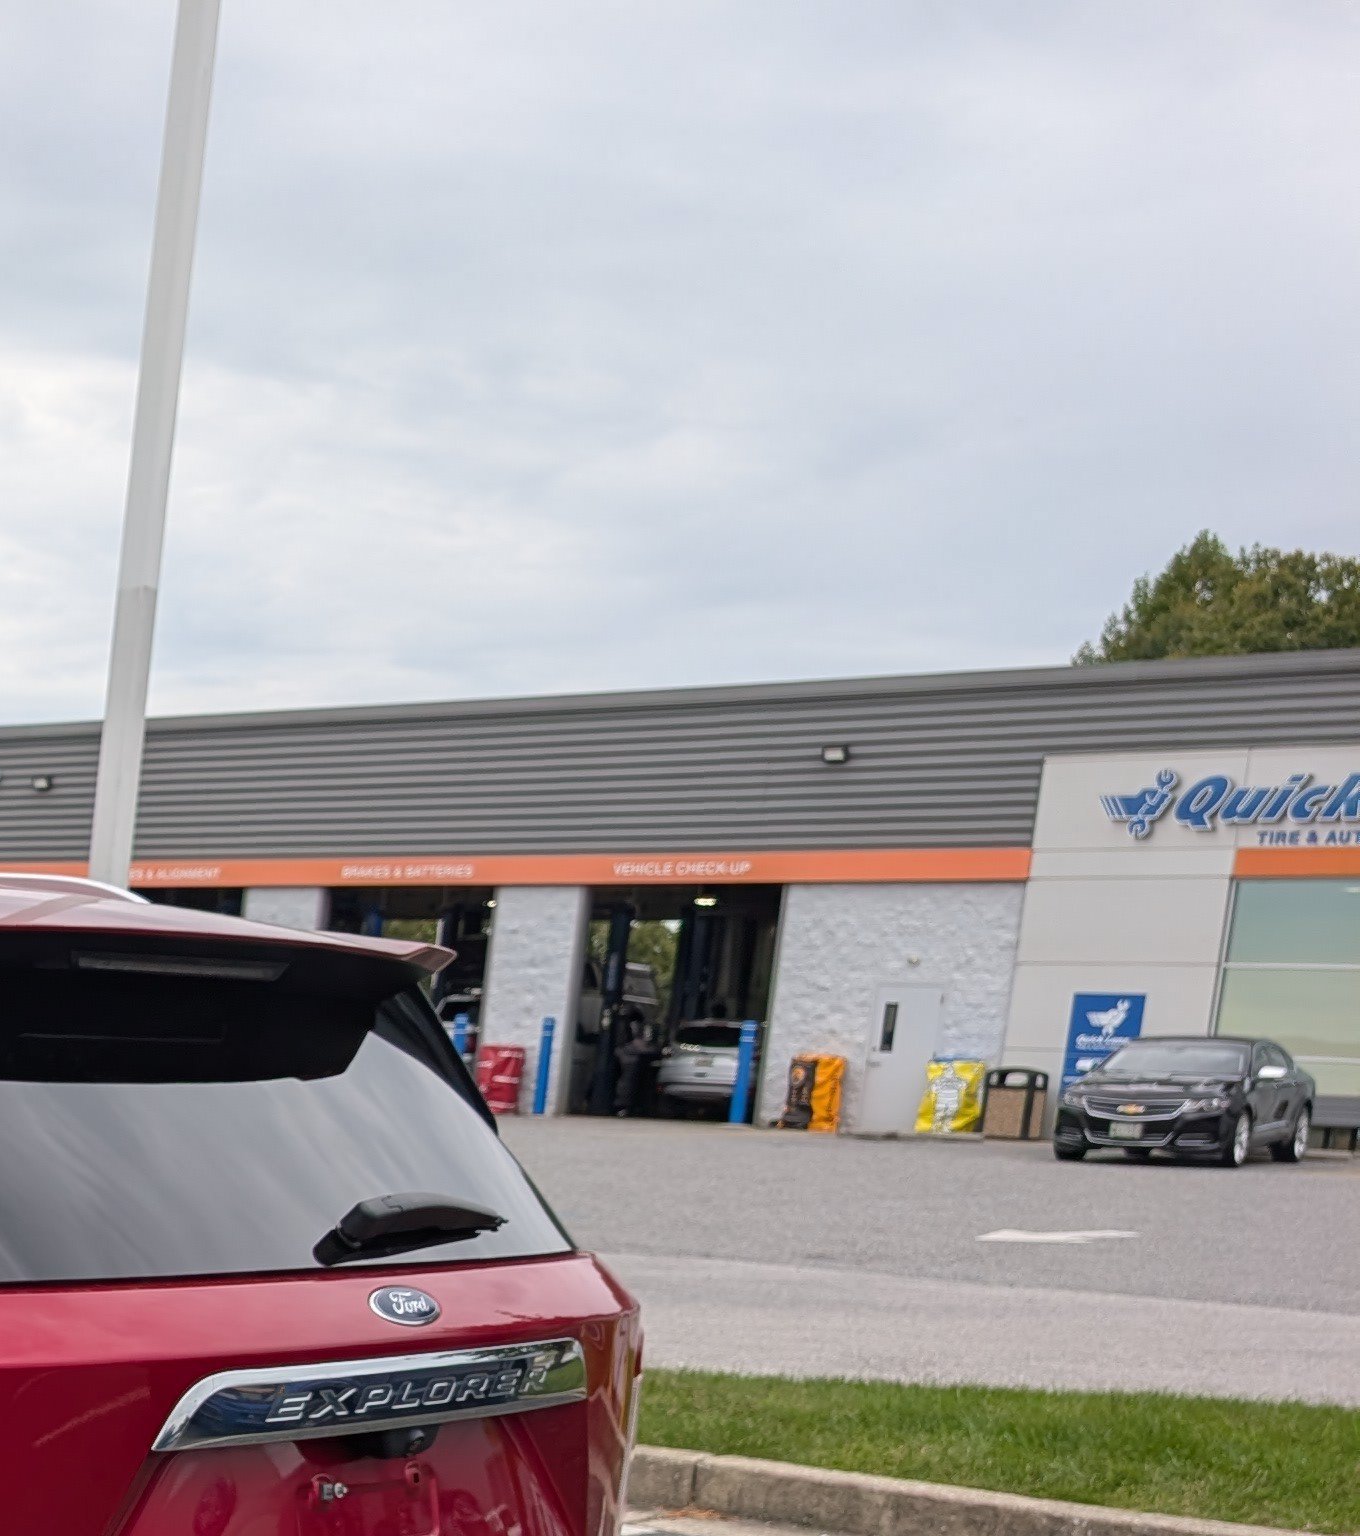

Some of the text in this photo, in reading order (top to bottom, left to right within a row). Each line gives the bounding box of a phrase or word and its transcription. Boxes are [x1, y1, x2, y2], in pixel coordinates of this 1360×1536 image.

[1174, 772, 1360, 831] Quick
[1258, 830, 1300, 845] TIRE
[1307, 830, 1318, 844] &
[341, 865, 390, 879] BRAKES
[404, 863, 474, 878] BATTERIES
[613, 861, 673, 876] VEHICLE
[389, 1291, 429, 1314] Ford
[265, 1367, 548, 1423] EXPLORER
